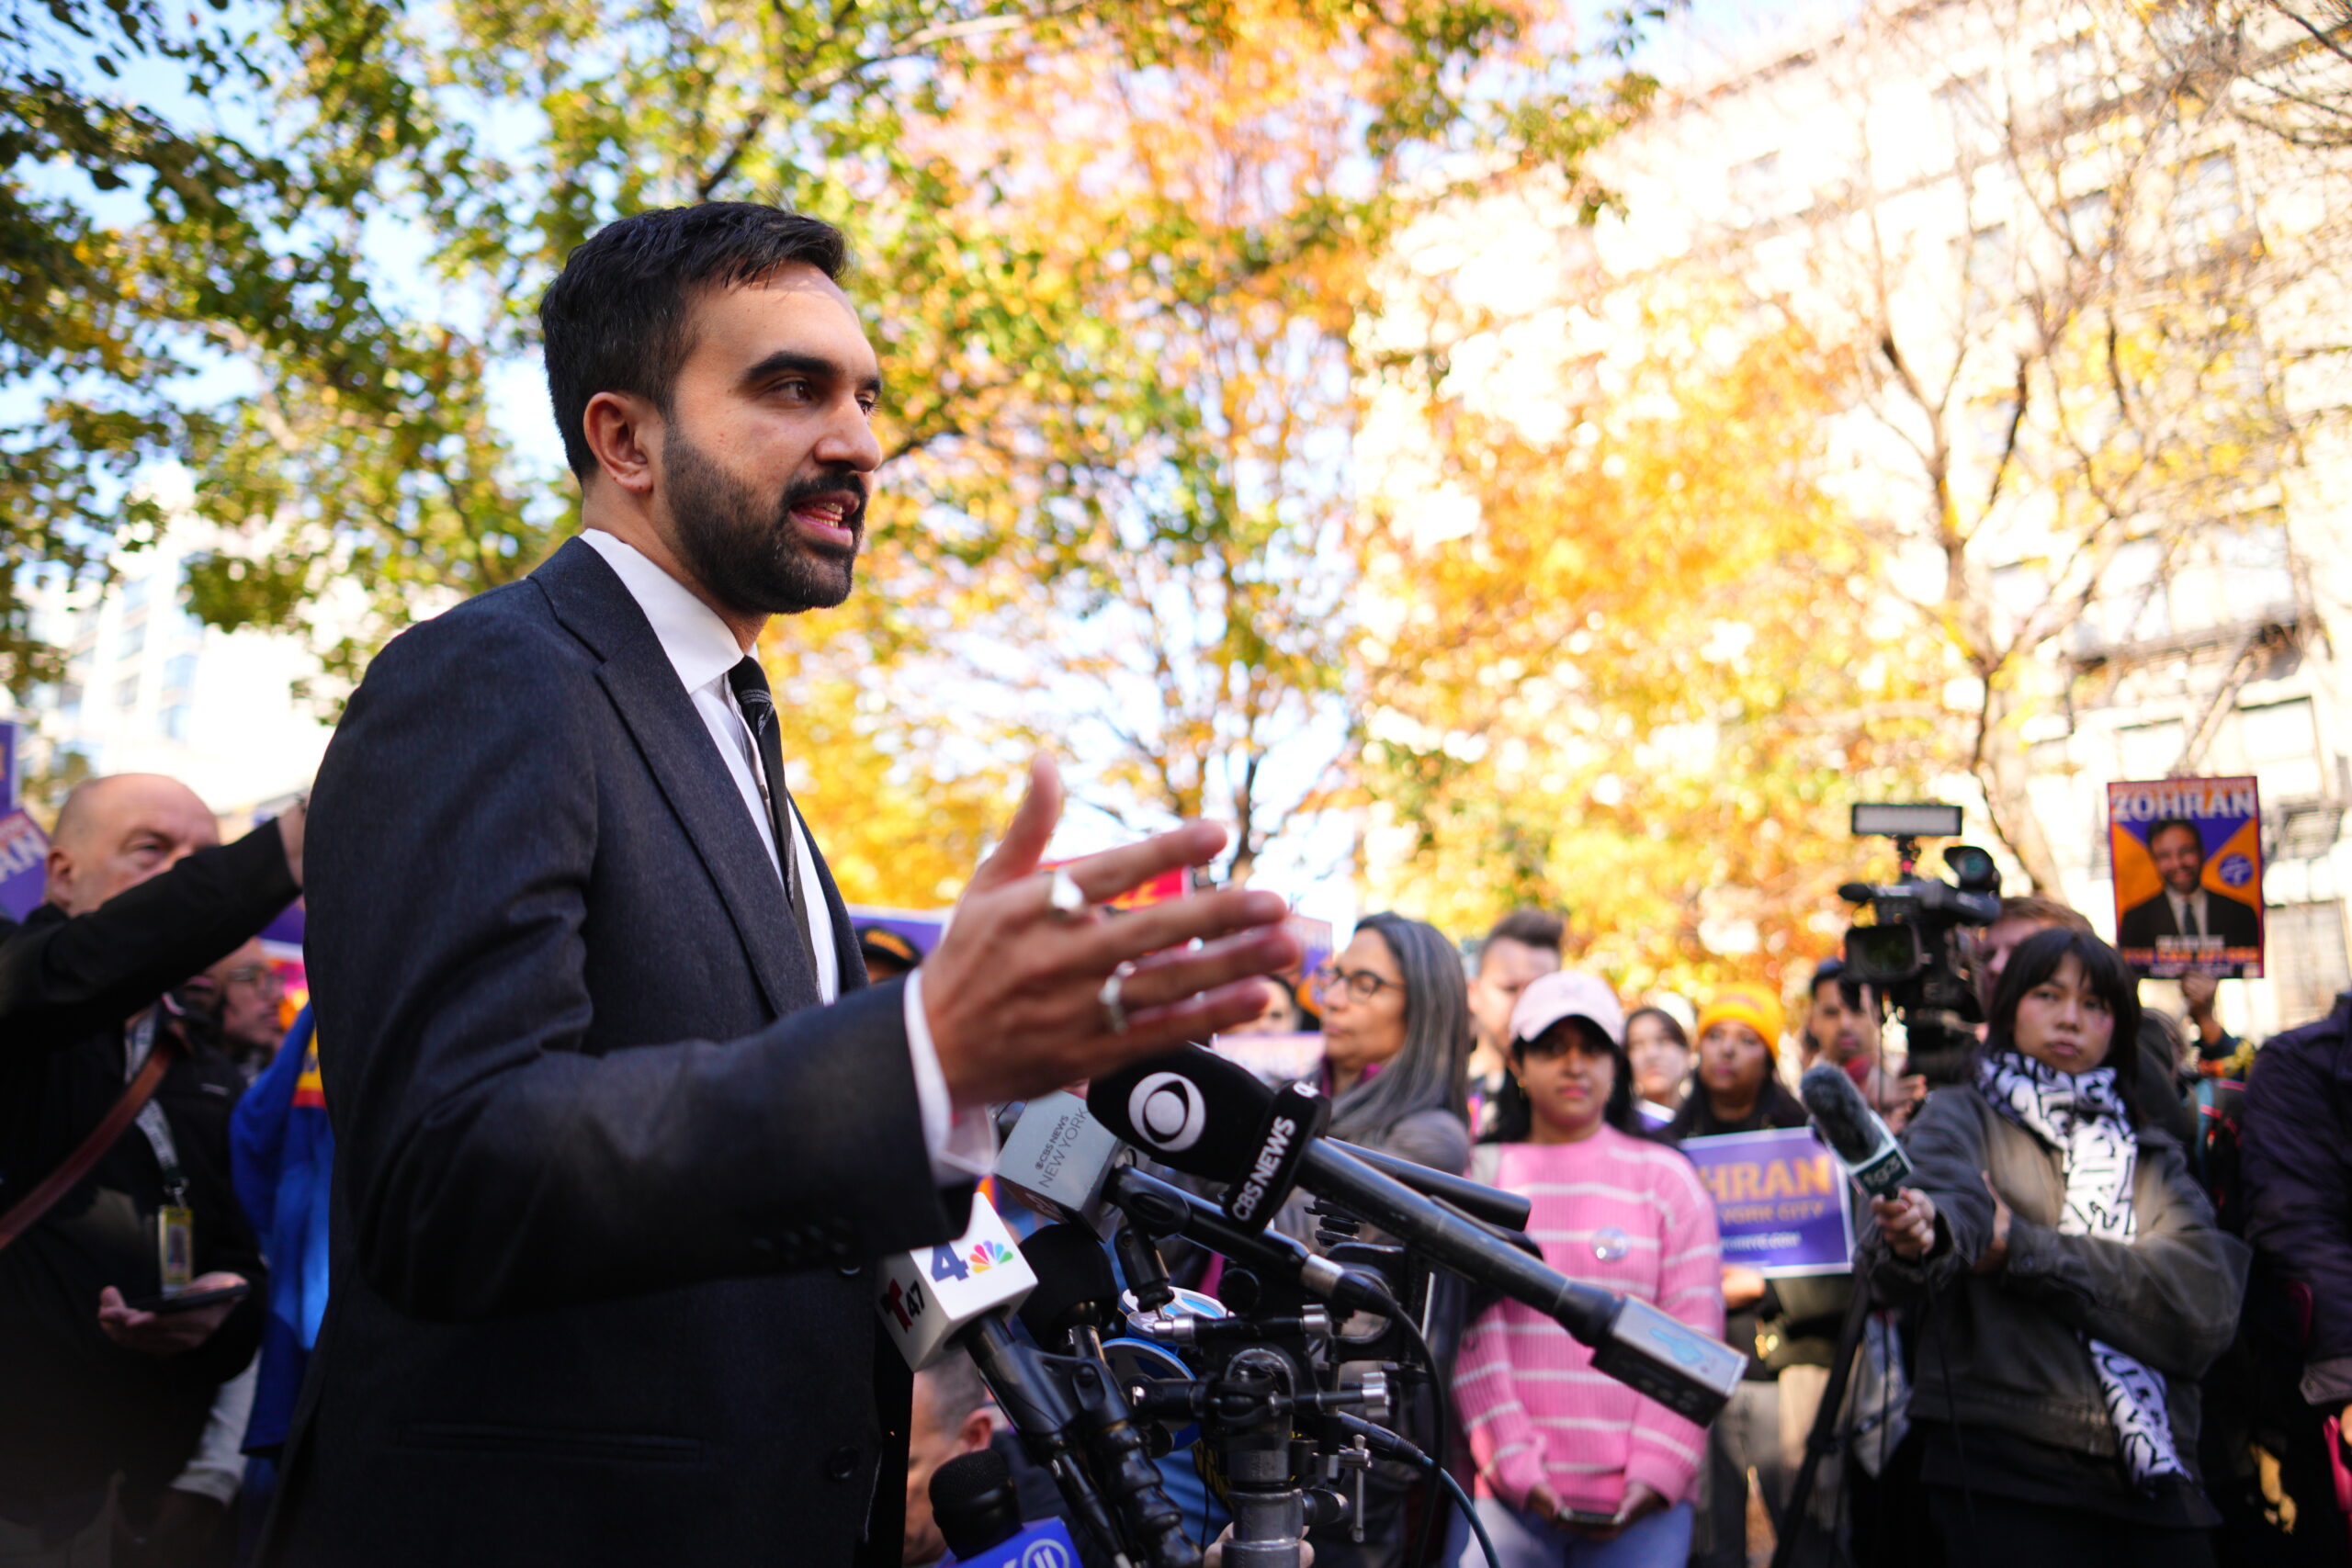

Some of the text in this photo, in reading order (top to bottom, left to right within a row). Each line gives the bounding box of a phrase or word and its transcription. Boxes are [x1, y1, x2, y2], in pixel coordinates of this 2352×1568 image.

[2113, 790, 2254, 821] ZOHRAN
[1038, 1149, 1066, 1189] NEW
[1058, 1107, 1090, 1148] YORK
[1039, 1115, 1069, 1163] CBS NEWS
[1232, 1115, 1296, 1221] CBS NEWS
[1699, 1155, 1831, 1202] HRAN
[931, 1241, 969, 1282] 4
[906, 1280, 925, 1317] 47
